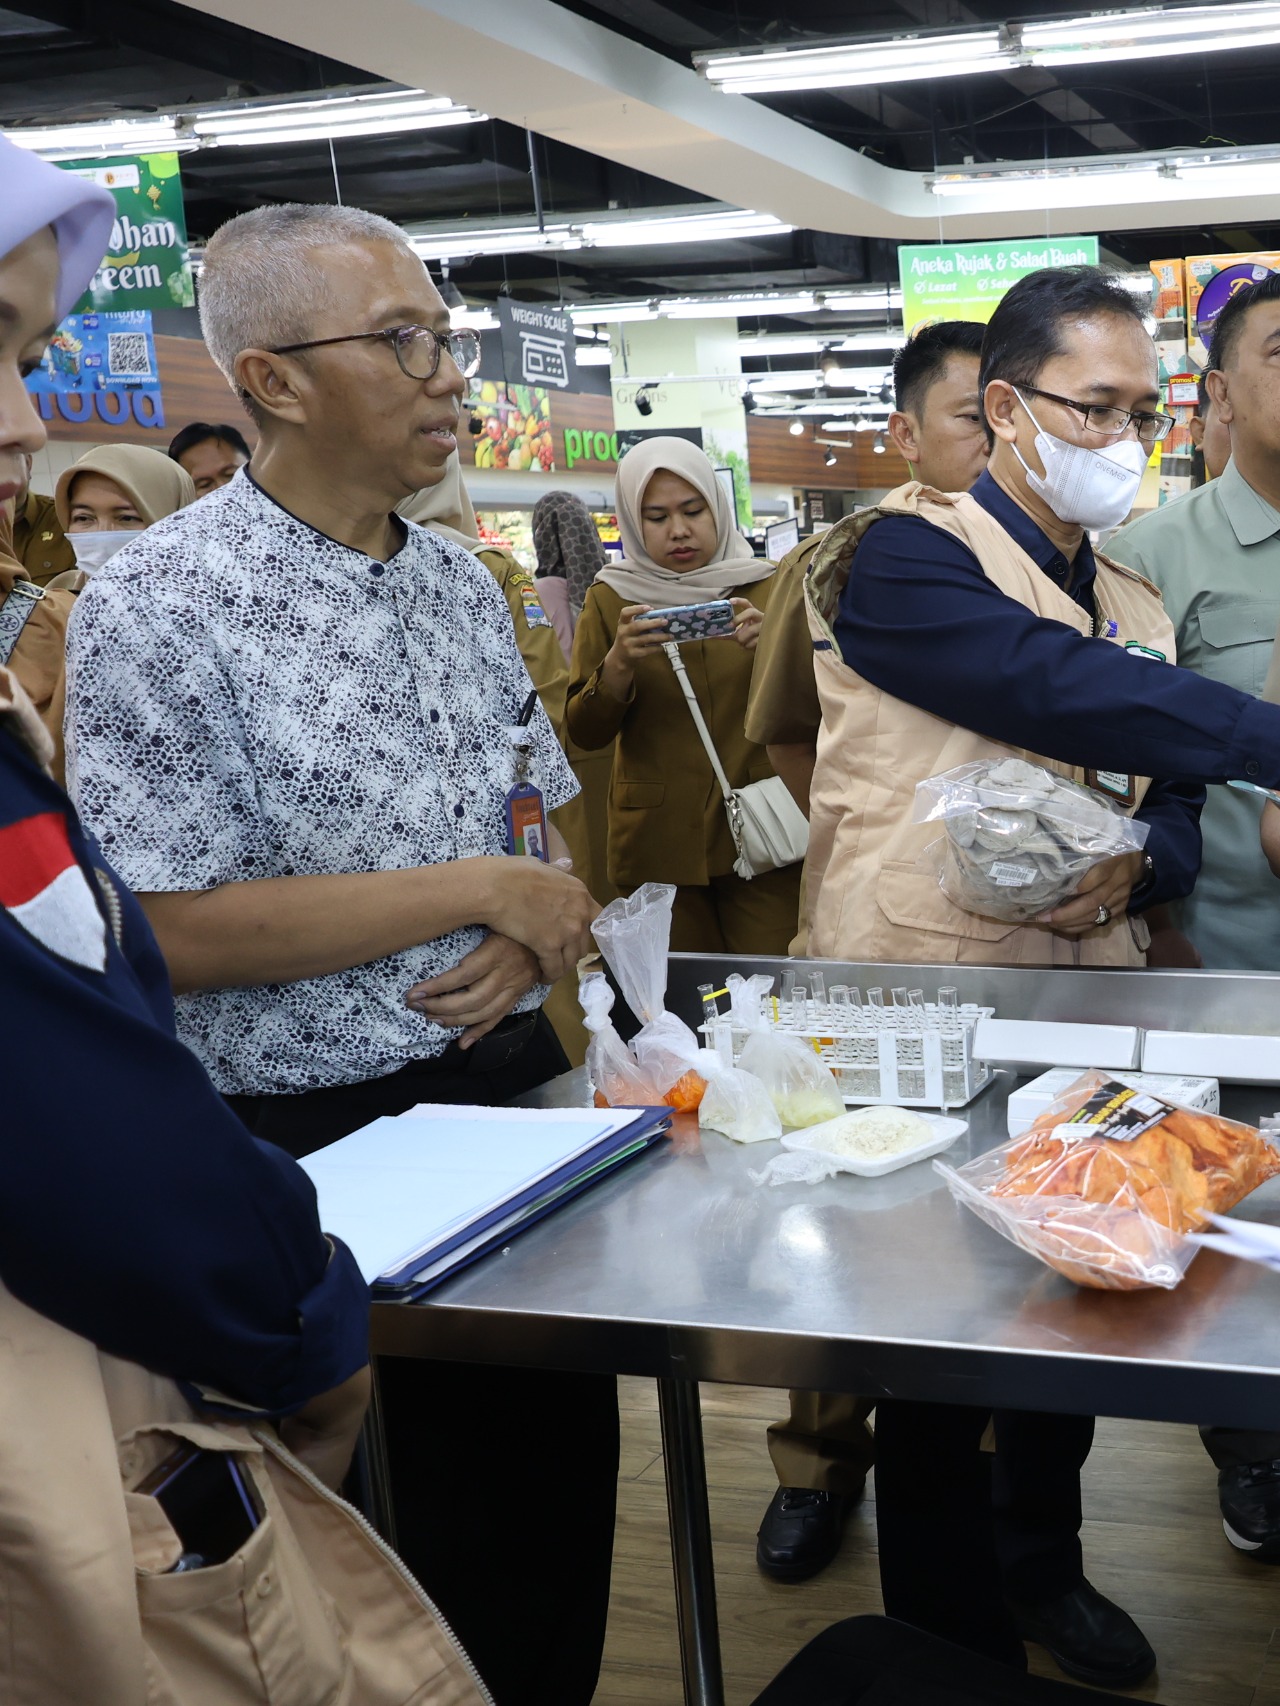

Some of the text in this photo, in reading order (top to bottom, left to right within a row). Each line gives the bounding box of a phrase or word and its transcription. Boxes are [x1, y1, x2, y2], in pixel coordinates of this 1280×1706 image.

[911, 247, 1087, 276] Aneka Rujak & Salad Buah
[510, 306, 568, 333] WEIGHT SCALE
[1095, 461, 1127, 482] ONEMED
